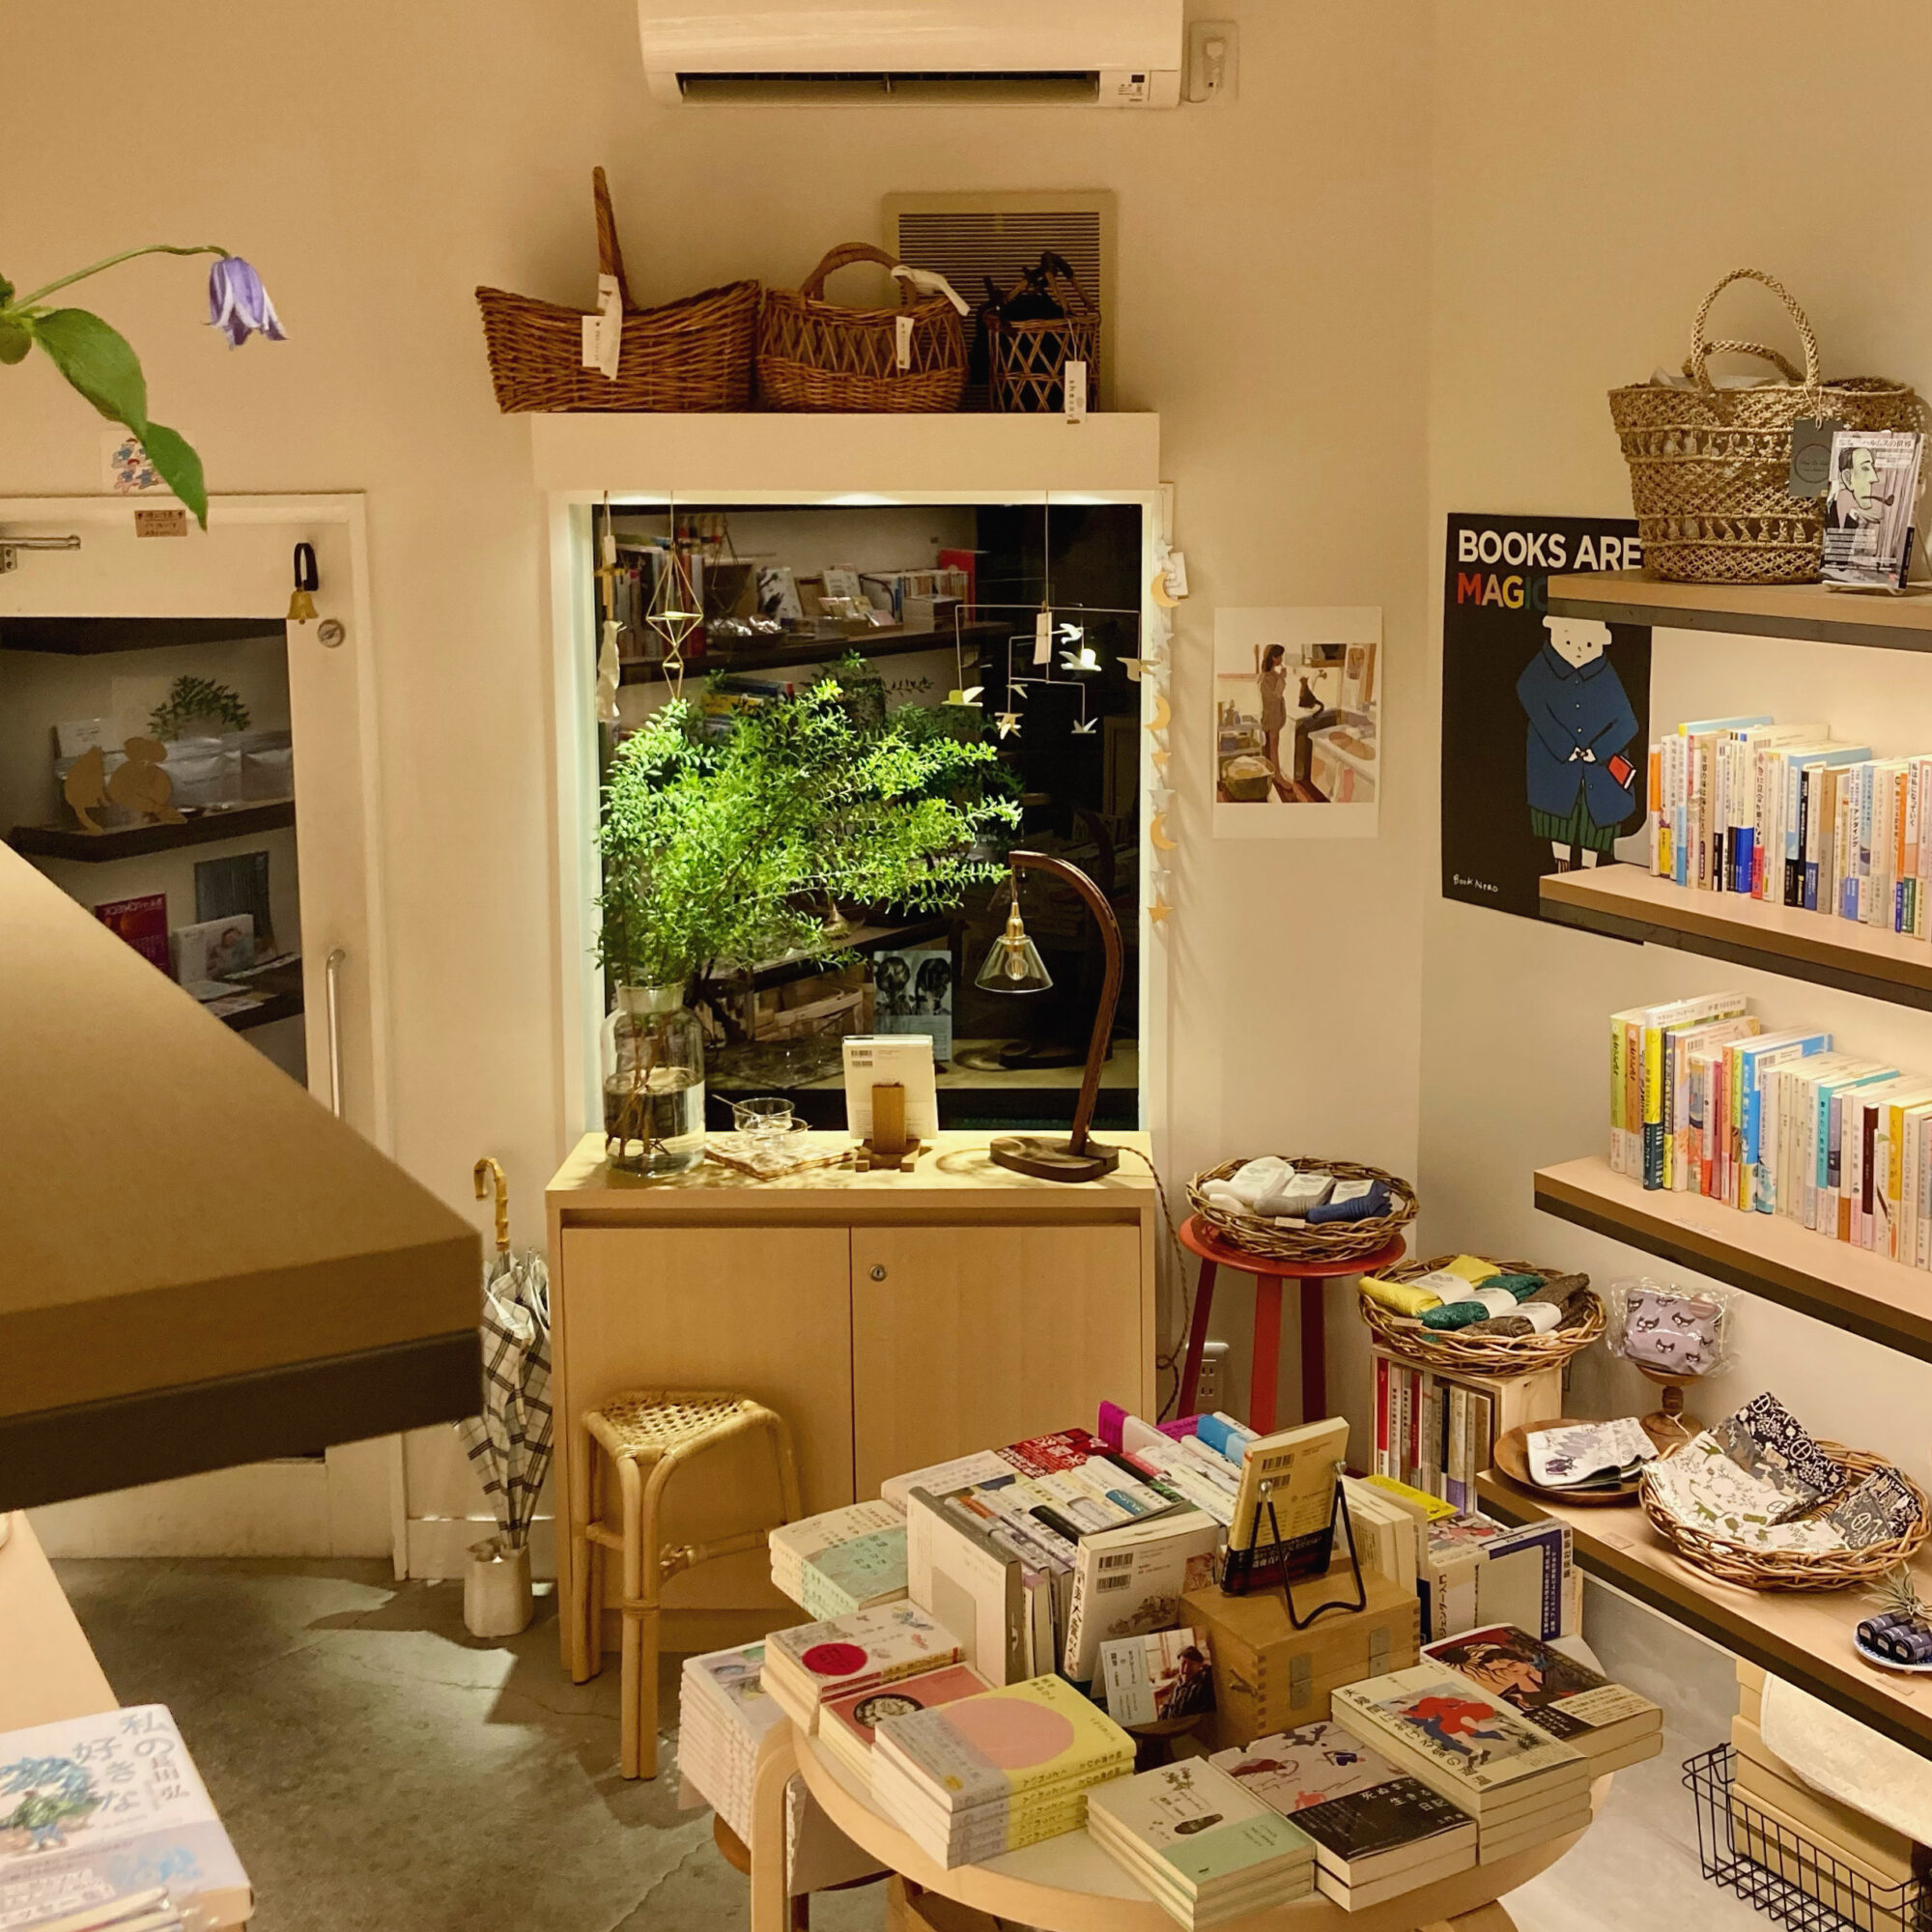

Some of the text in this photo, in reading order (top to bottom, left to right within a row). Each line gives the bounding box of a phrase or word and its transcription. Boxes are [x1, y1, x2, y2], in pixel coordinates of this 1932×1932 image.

[1458, 528, 1643, 571] BOOKS ARE
[1755, 765, 1765, 845] 急に具合が悪くなる
[1910, 762, 1918, 828] 私は私になっていく
[1851, 809, 1860, 848] アンダイング
[1452, 873, 1474, 886] Book
[1438, 1574, 1448, 1639] ジェンダー入門
[119, 1710, 176, 1758] 私の
[1345, 1689, 1493, 1787] 夫婦間における愛の適温
[71, 1736, 142, 1814] 好きな
[1359, 1778, 1417, 1802] 死ぬまで
[1388, 1788, 1434, 1806] 生きる
[1417, 1798, 1450, 1812] 日記
